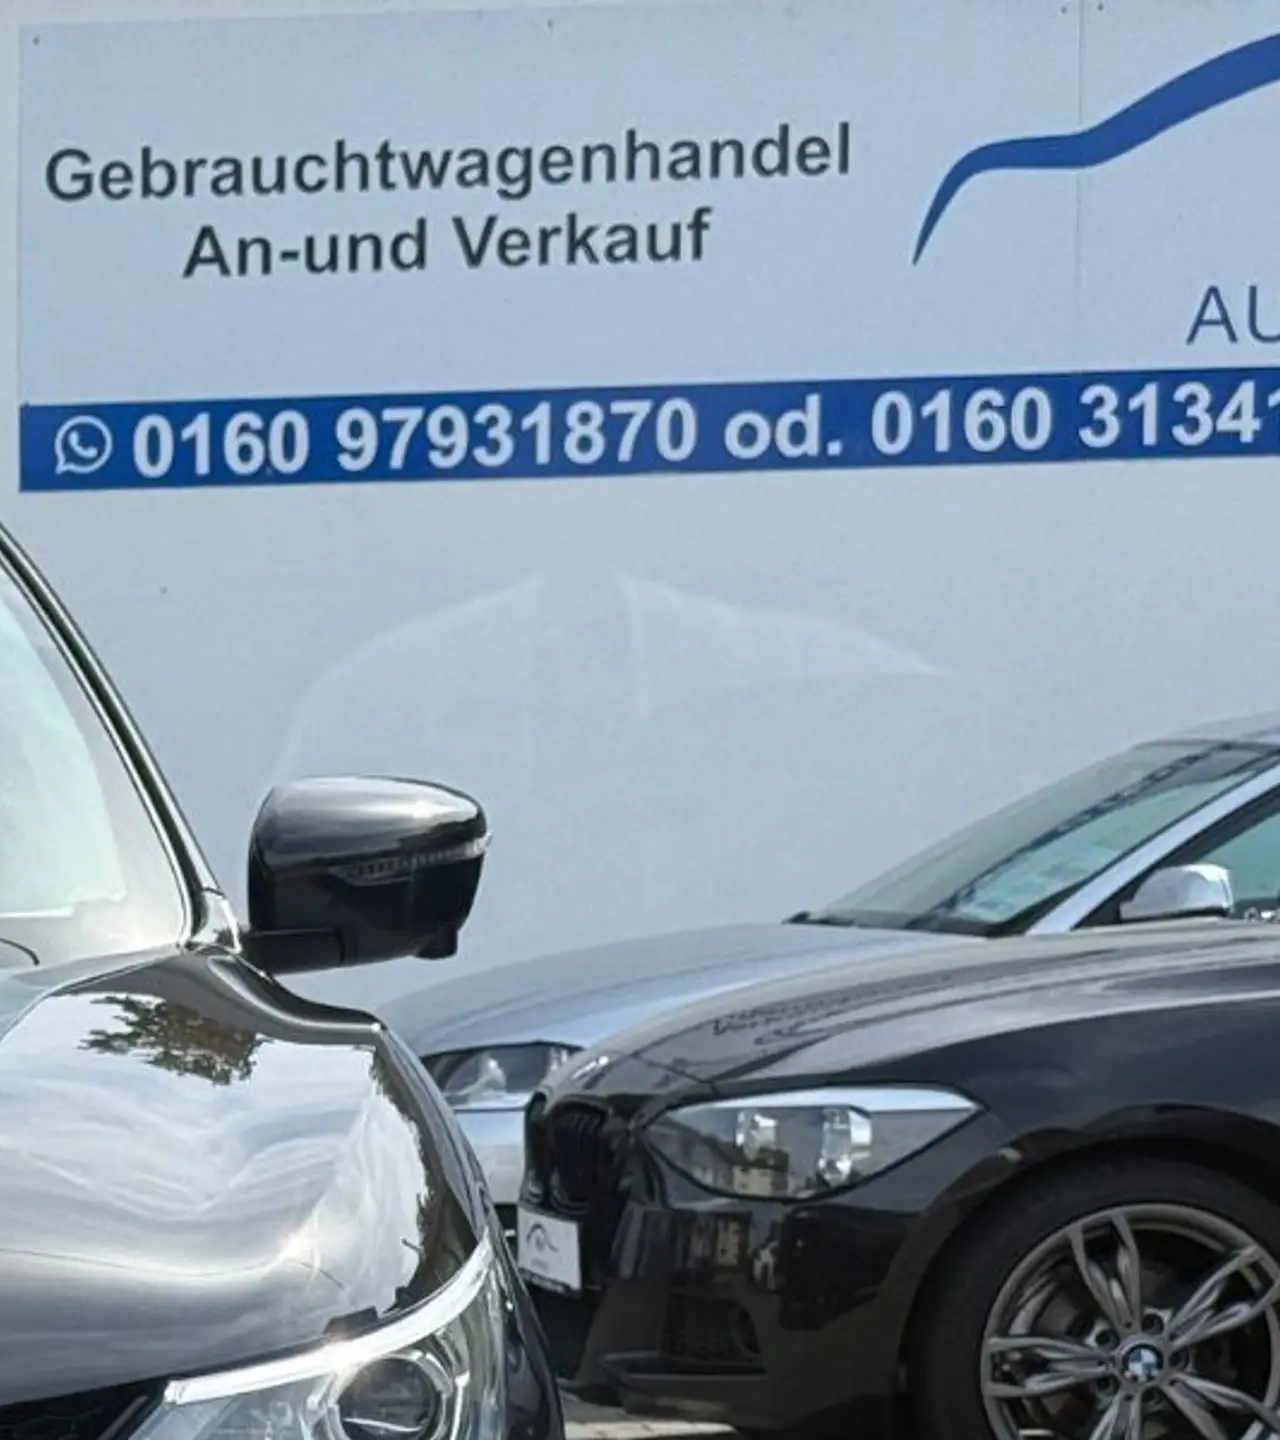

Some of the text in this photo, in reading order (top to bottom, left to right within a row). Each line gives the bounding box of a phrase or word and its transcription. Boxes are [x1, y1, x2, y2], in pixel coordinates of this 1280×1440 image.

[45, 121, 851, 203] Gebrauchtwagenhandel
[183, 205, 714, 279] An-und Verkauf
[132, 410, 310, 479] 0160
[335, 397, 698, 473] 97931870
[723, 392, 844, 460] od.
[870, 385, 1053, 456] 0160
